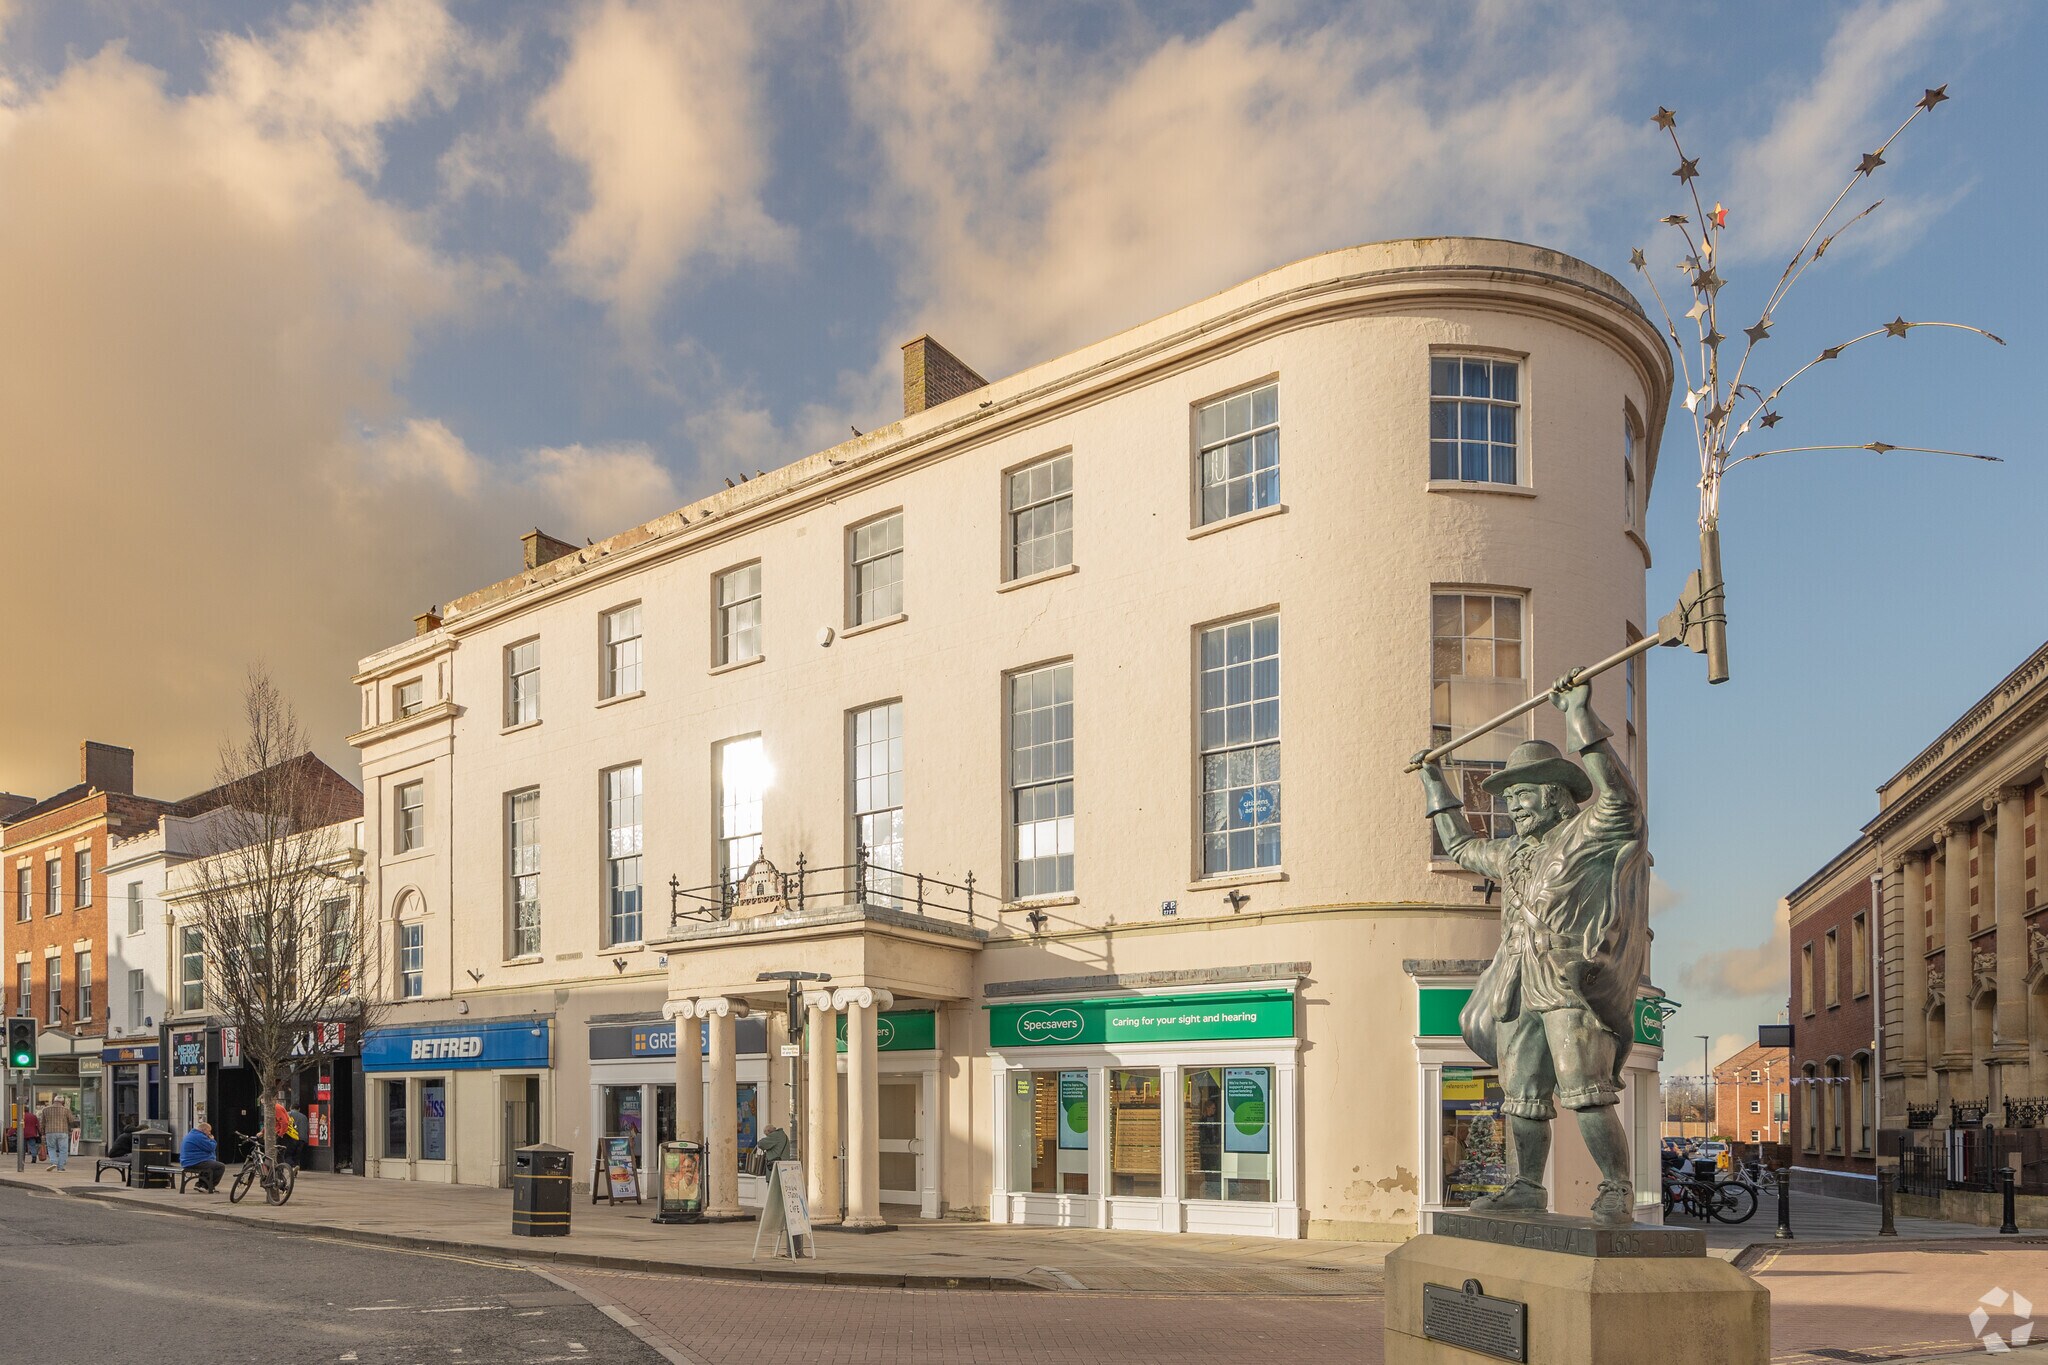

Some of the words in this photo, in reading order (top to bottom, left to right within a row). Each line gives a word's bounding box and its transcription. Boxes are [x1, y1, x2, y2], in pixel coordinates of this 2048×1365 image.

[1023, 1019, 1078, 1032] Specsavers
[1112, 1017, 1140, 1028] Caring
[1141, 1015, 1154, 1025] for
[1156, 1015, 1177, 1026] your
[1178, 1013, 1200, 1025] sight
[1202, 1013, 1220, 1023] and
[1221, 1011, 1257, 1024] hearing
[411, 1036, 482, 1060] BETFRED
[649, 1030, 707, 1050] GRES
[133, 1048, 144, 1059] HILL
[177, 1043, 200, 1056] NERDZ
[424, 1100, 445, 1118] MISS
[1440, 1216, 1482, 1239] SPIRIT
[1487, 1220, 1507, 1243] OF
[1512, 1223, 1590, 1254] CARNIVAL
[1608, 1233, 1641, 1253] 1605
[1662, 1232, 1696, 1253] 2005
